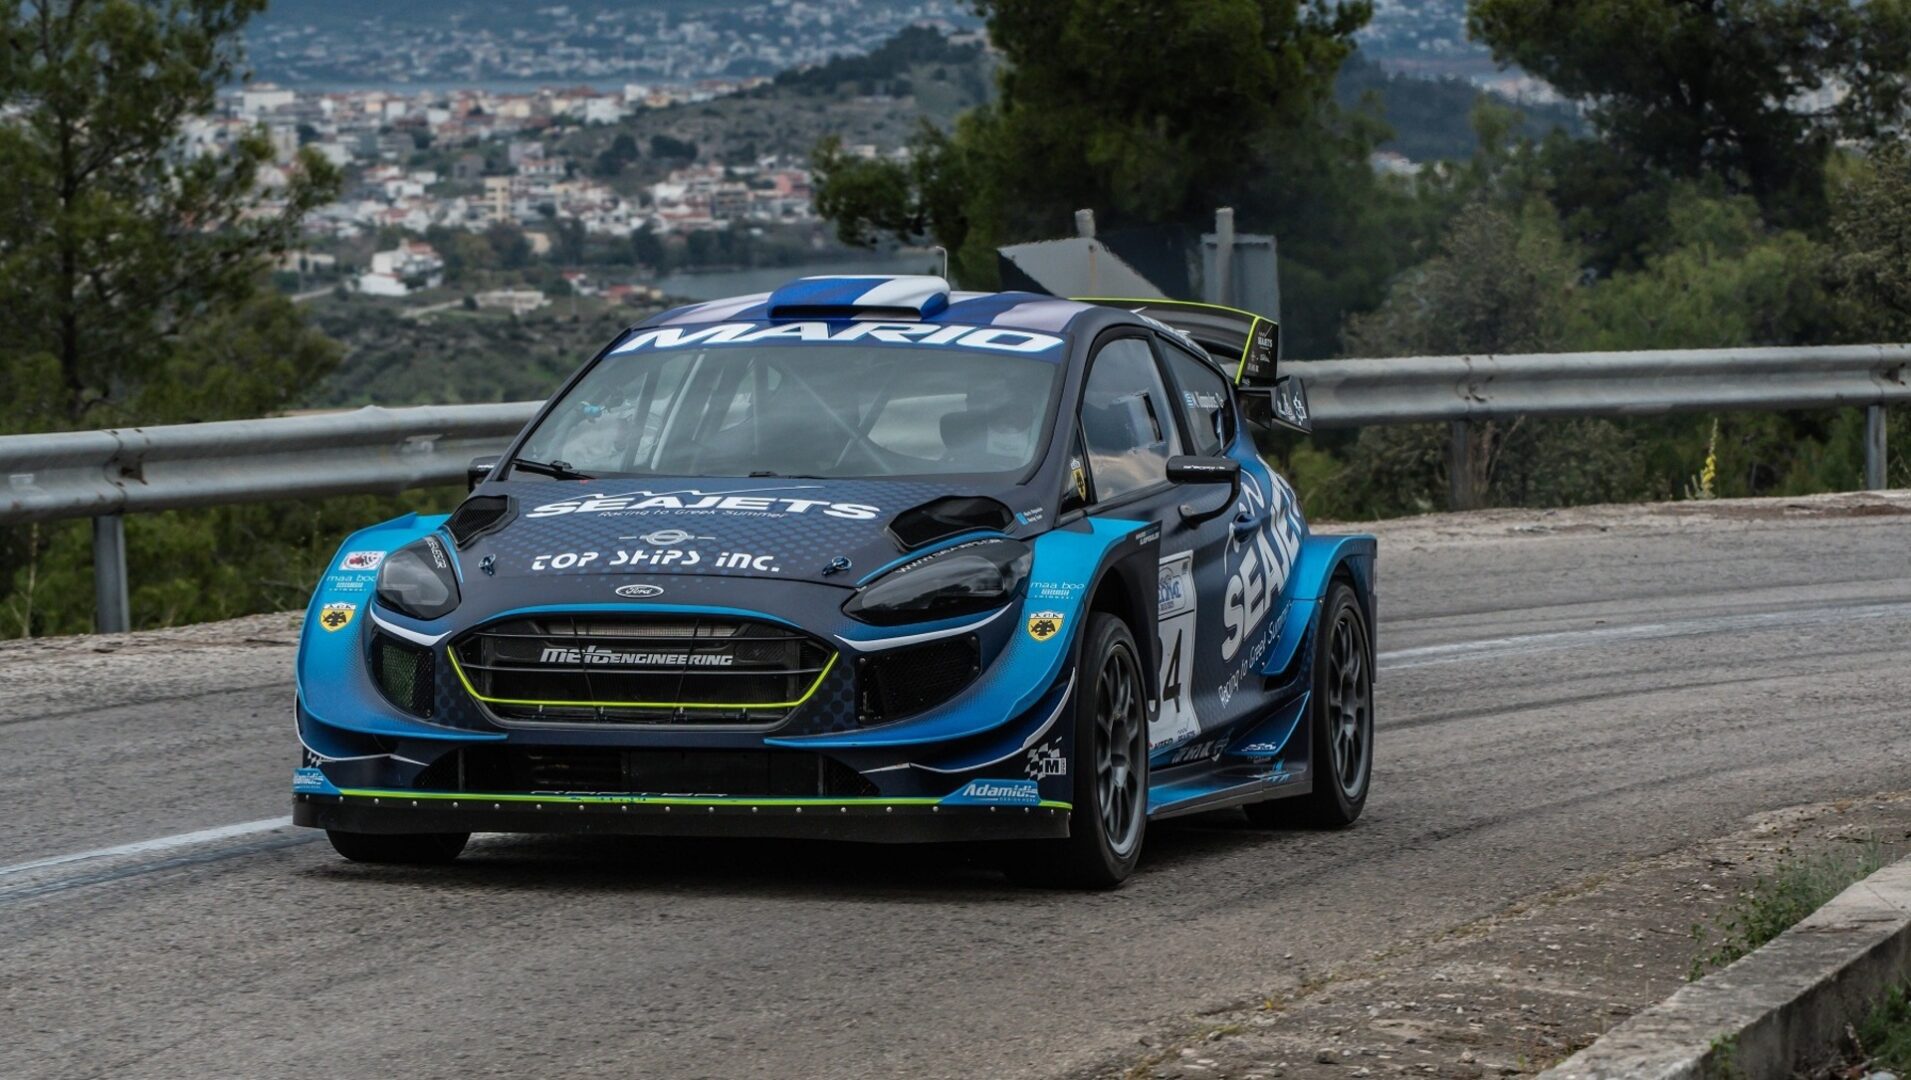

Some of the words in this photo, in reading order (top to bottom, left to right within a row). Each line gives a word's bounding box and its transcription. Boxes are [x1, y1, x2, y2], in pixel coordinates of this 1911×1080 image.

[609, 321, 1065, 355] MARIO
[526, 496, 882, 520] SEAJETS
[599, 509, 650, 518] Racing
[722, 509, 790, 519] Summer
[531, 552, 599, 571] TOP
